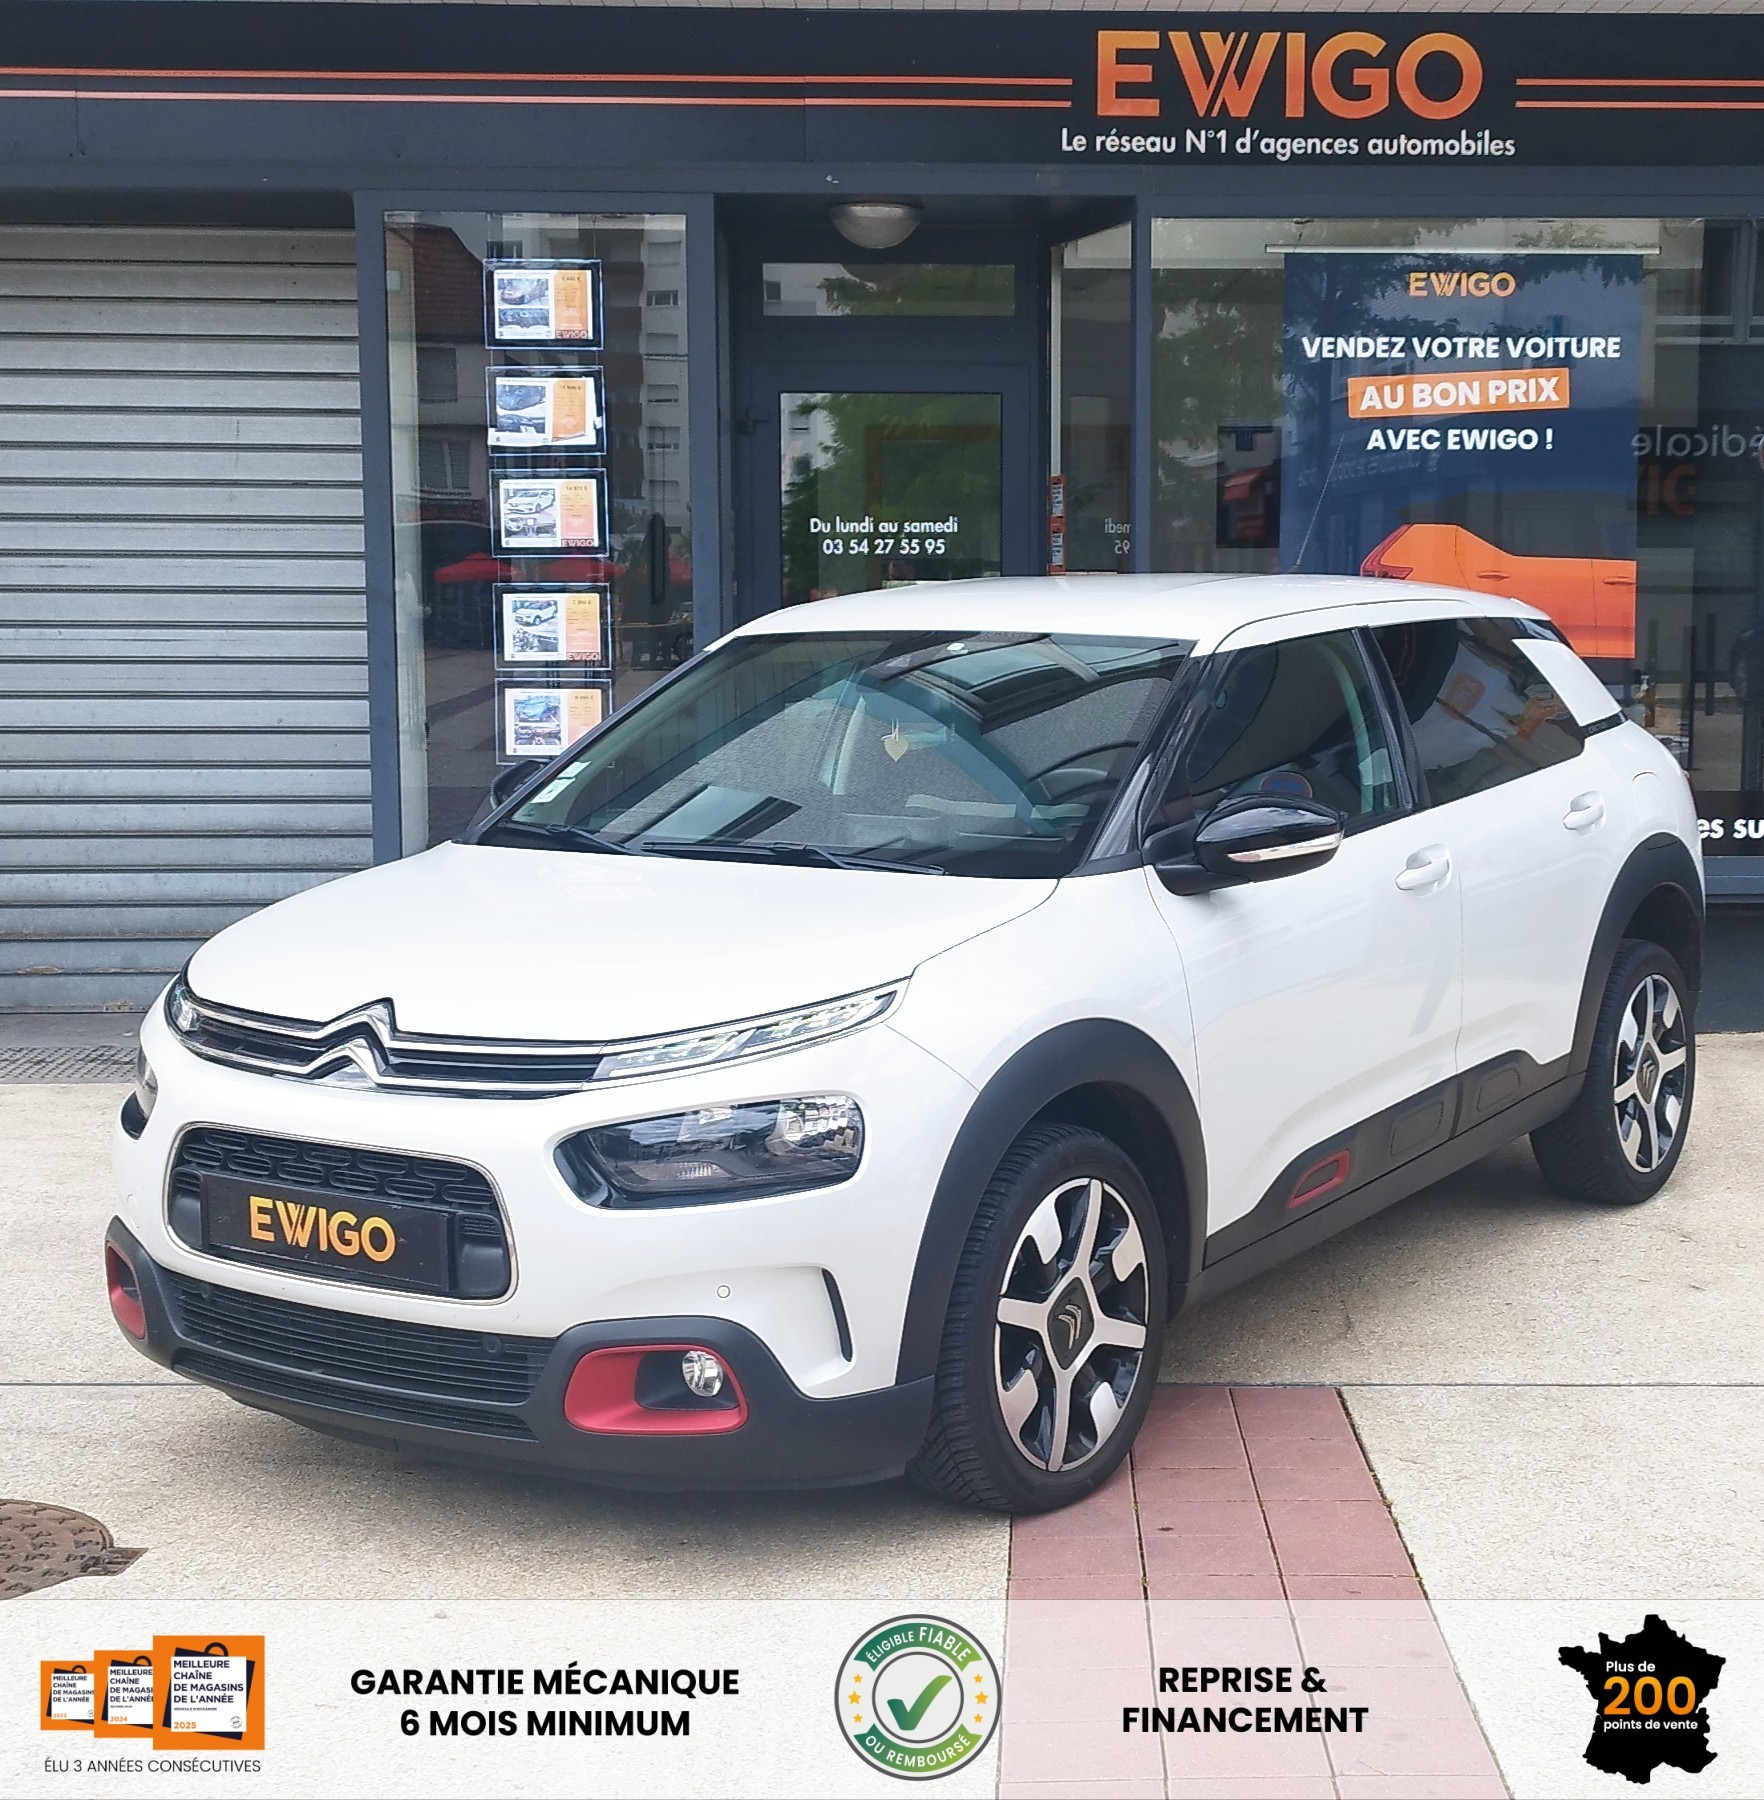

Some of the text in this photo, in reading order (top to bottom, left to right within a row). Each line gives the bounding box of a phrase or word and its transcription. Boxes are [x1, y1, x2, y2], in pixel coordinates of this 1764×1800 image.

[1096, 30, 1484, 120] EWIGO
[1061, 127, 1088, 152] Le
[1095, 127, 1176, 152] réseau
[1235, 127, 1359, 162] d'agences
[1367, 129, 1516, 156] automobiles
[1409, 272, 1517, 298] EWIGO
[1302, 336, 1621, 359] VENDEZ VOTRE VOITURE
[1360, 376, 1560, 411] AU BON PRIX
[1366, 428, 1554, 451] AVEC EWIGO !
[810, 515, 959, 533] Du lundi au samedi
[822, 538, 946, 555] 03 54 27 55 95
[249, 1195, 396, 1262] EWIGO
